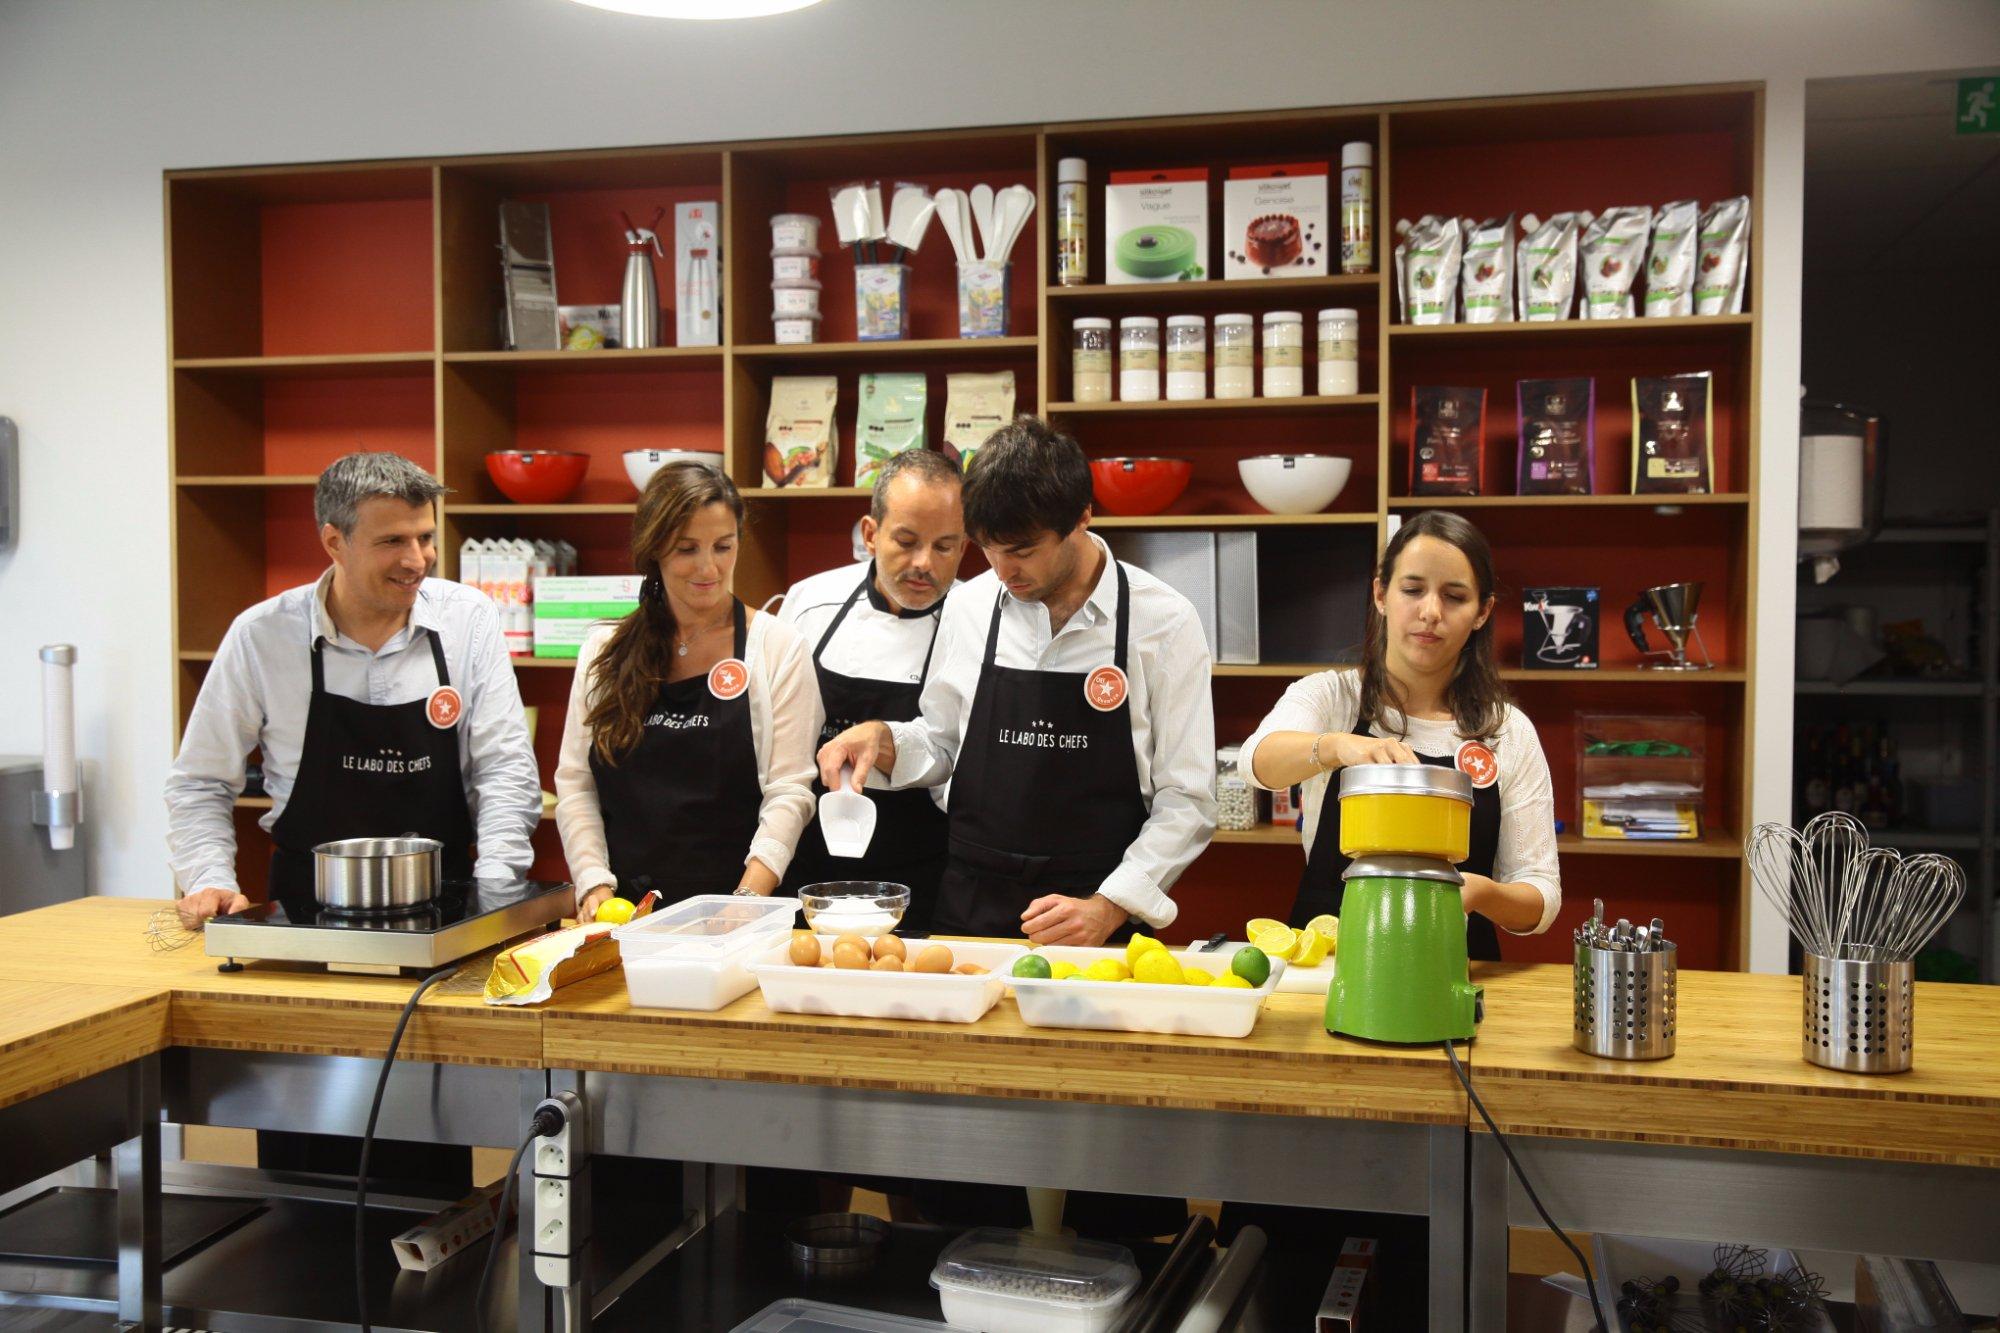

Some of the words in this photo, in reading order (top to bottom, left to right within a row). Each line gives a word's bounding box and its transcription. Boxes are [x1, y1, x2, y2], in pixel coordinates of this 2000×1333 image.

[663, 718, 682, 729] DES
[998, 728, 1010, 743] LE
[1011, 730, 1035, 746] LABO
[1037, 733, 1055, 748] DES
[1059, 734, 1088, 749] CHEFS
[342, 755, 354, 769] LE
[357, 757, 384, 772] LABO
[386, 760, 405, 773] DES
[407, 755, 431, 773] CHEFS
